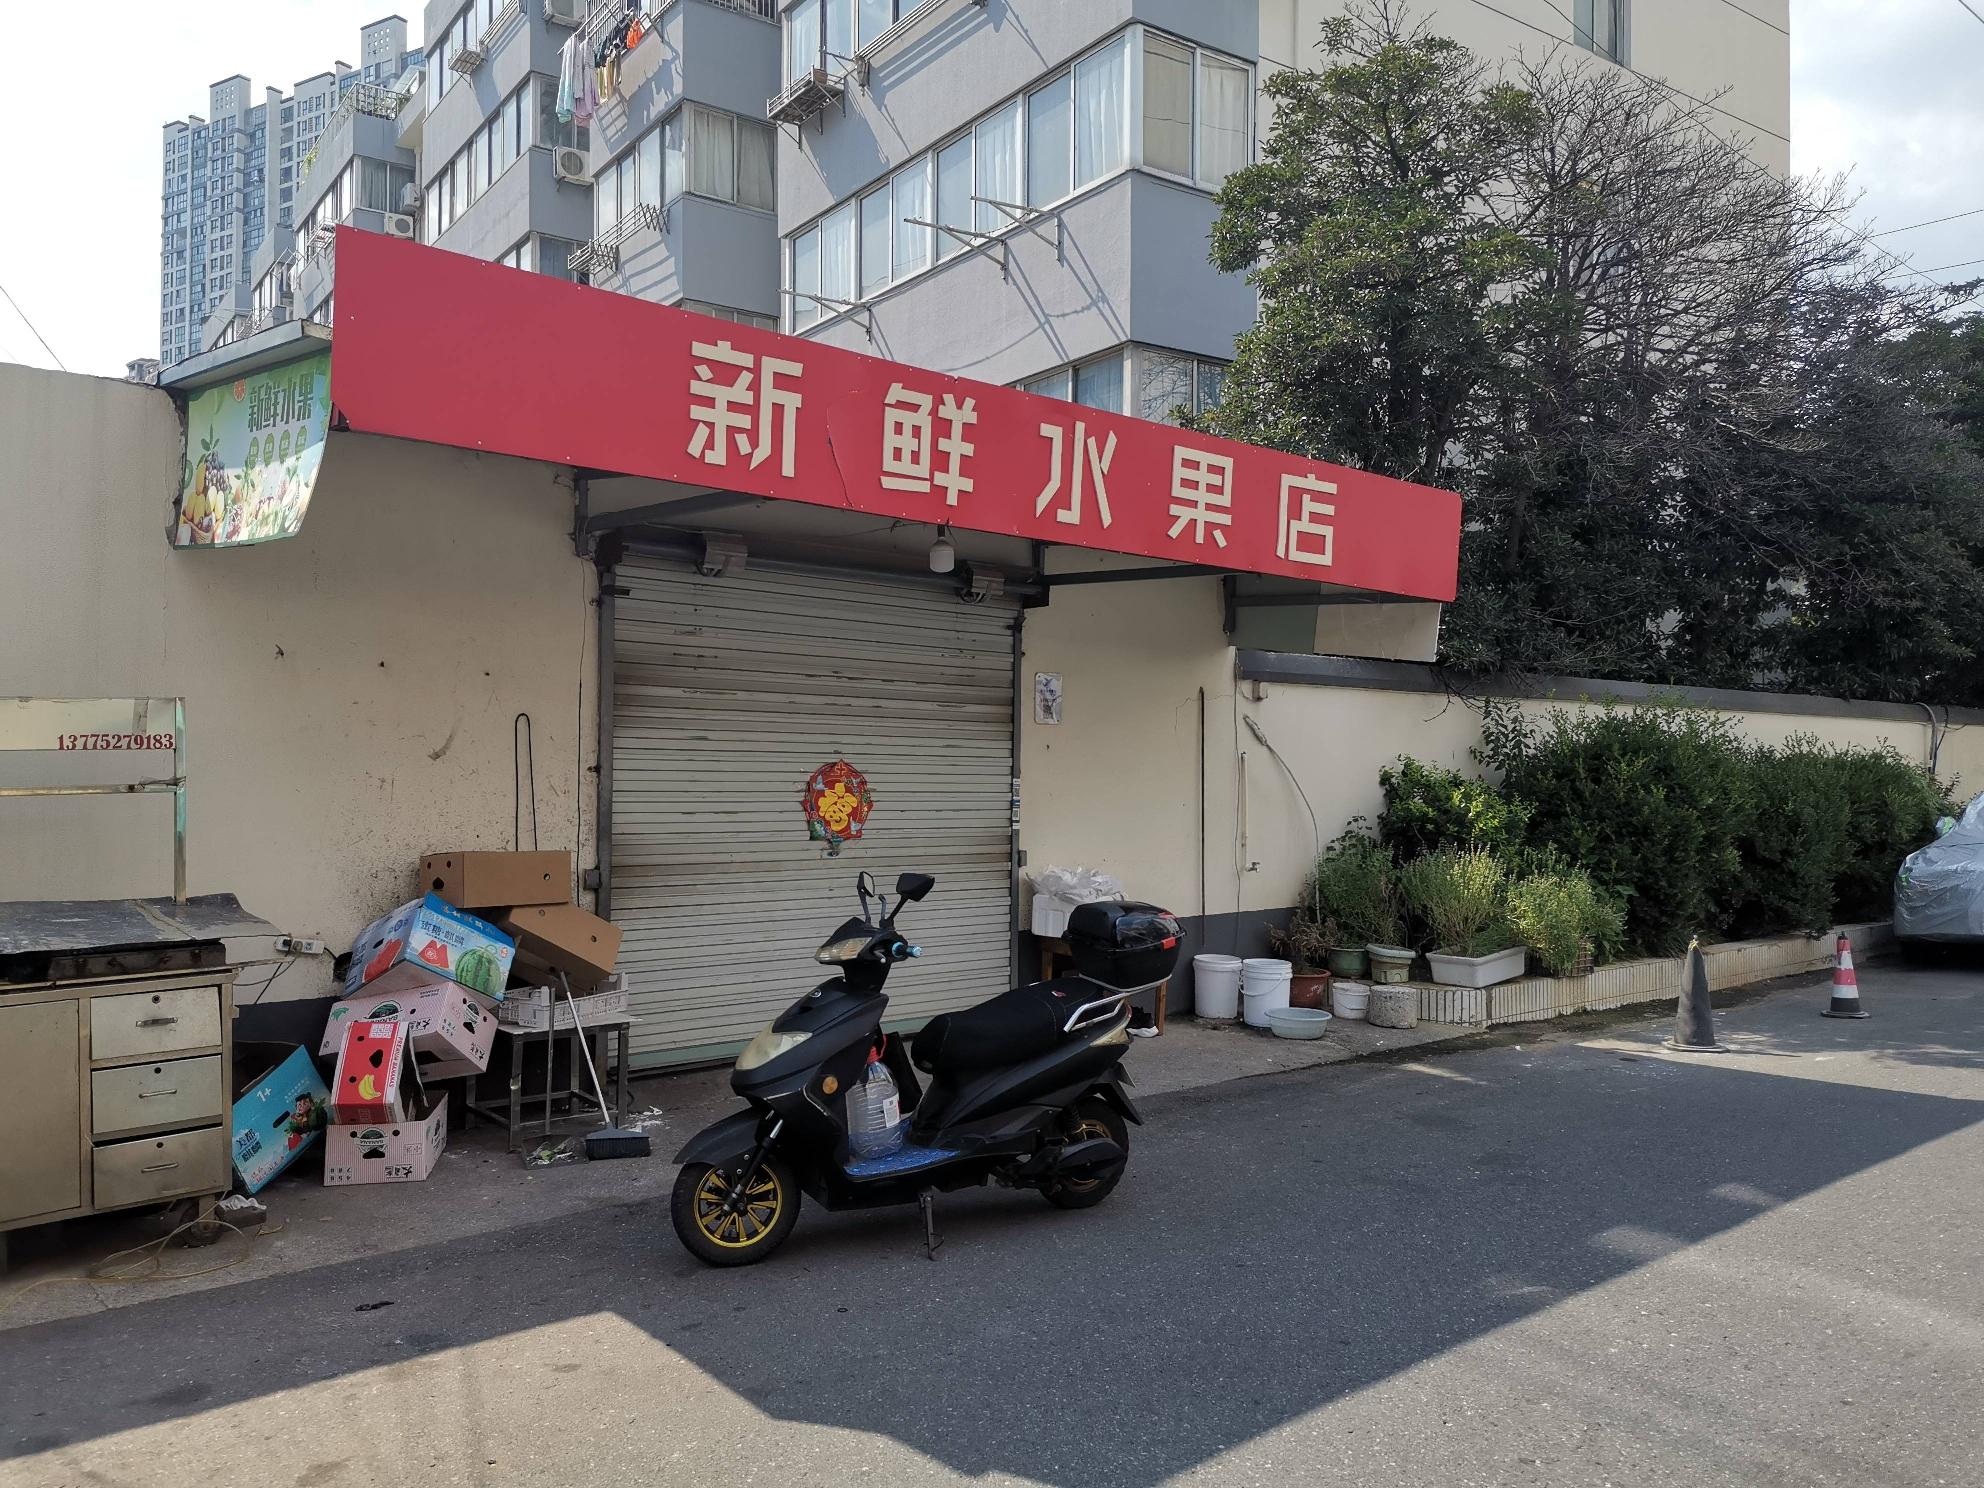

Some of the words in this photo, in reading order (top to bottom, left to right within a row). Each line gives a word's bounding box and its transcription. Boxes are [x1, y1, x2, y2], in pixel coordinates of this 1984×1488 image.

[248, 373, 315, 432] 新鲜水果
[686, 340, 1339, 567] 新鲜水果店
[58, 733, 175, 750] 13775279183
